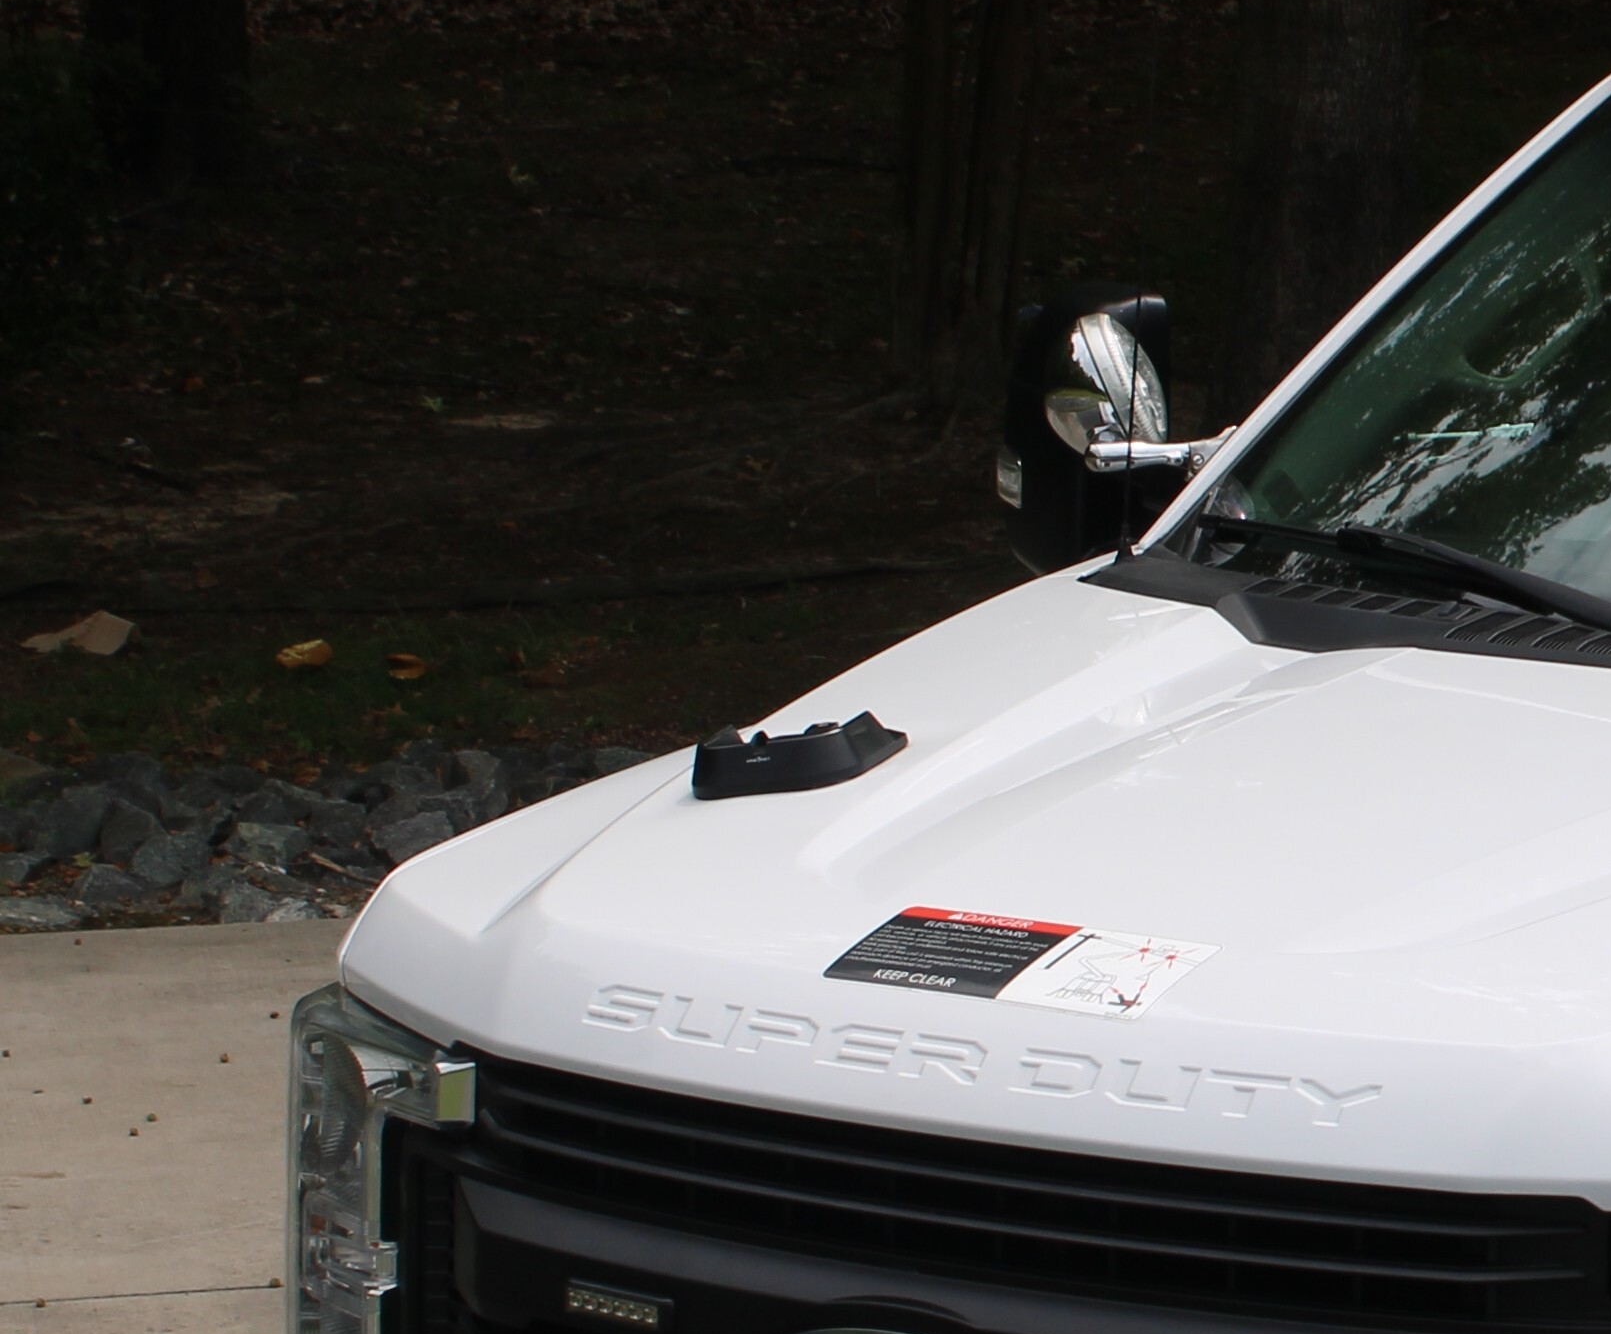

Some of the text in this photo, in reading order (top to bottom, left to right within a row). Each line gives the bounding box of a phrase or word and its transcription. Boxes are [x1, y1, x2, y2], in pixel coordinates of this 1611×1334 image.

[924, 920, 1029, 938] ELECTRICAL HAZARD
[961, 912, 1034, 929] DANGER
[873, 968, 957, 988] KEEP CLEAR
[581, 983, 1384, 1127] SUPER DUTY
